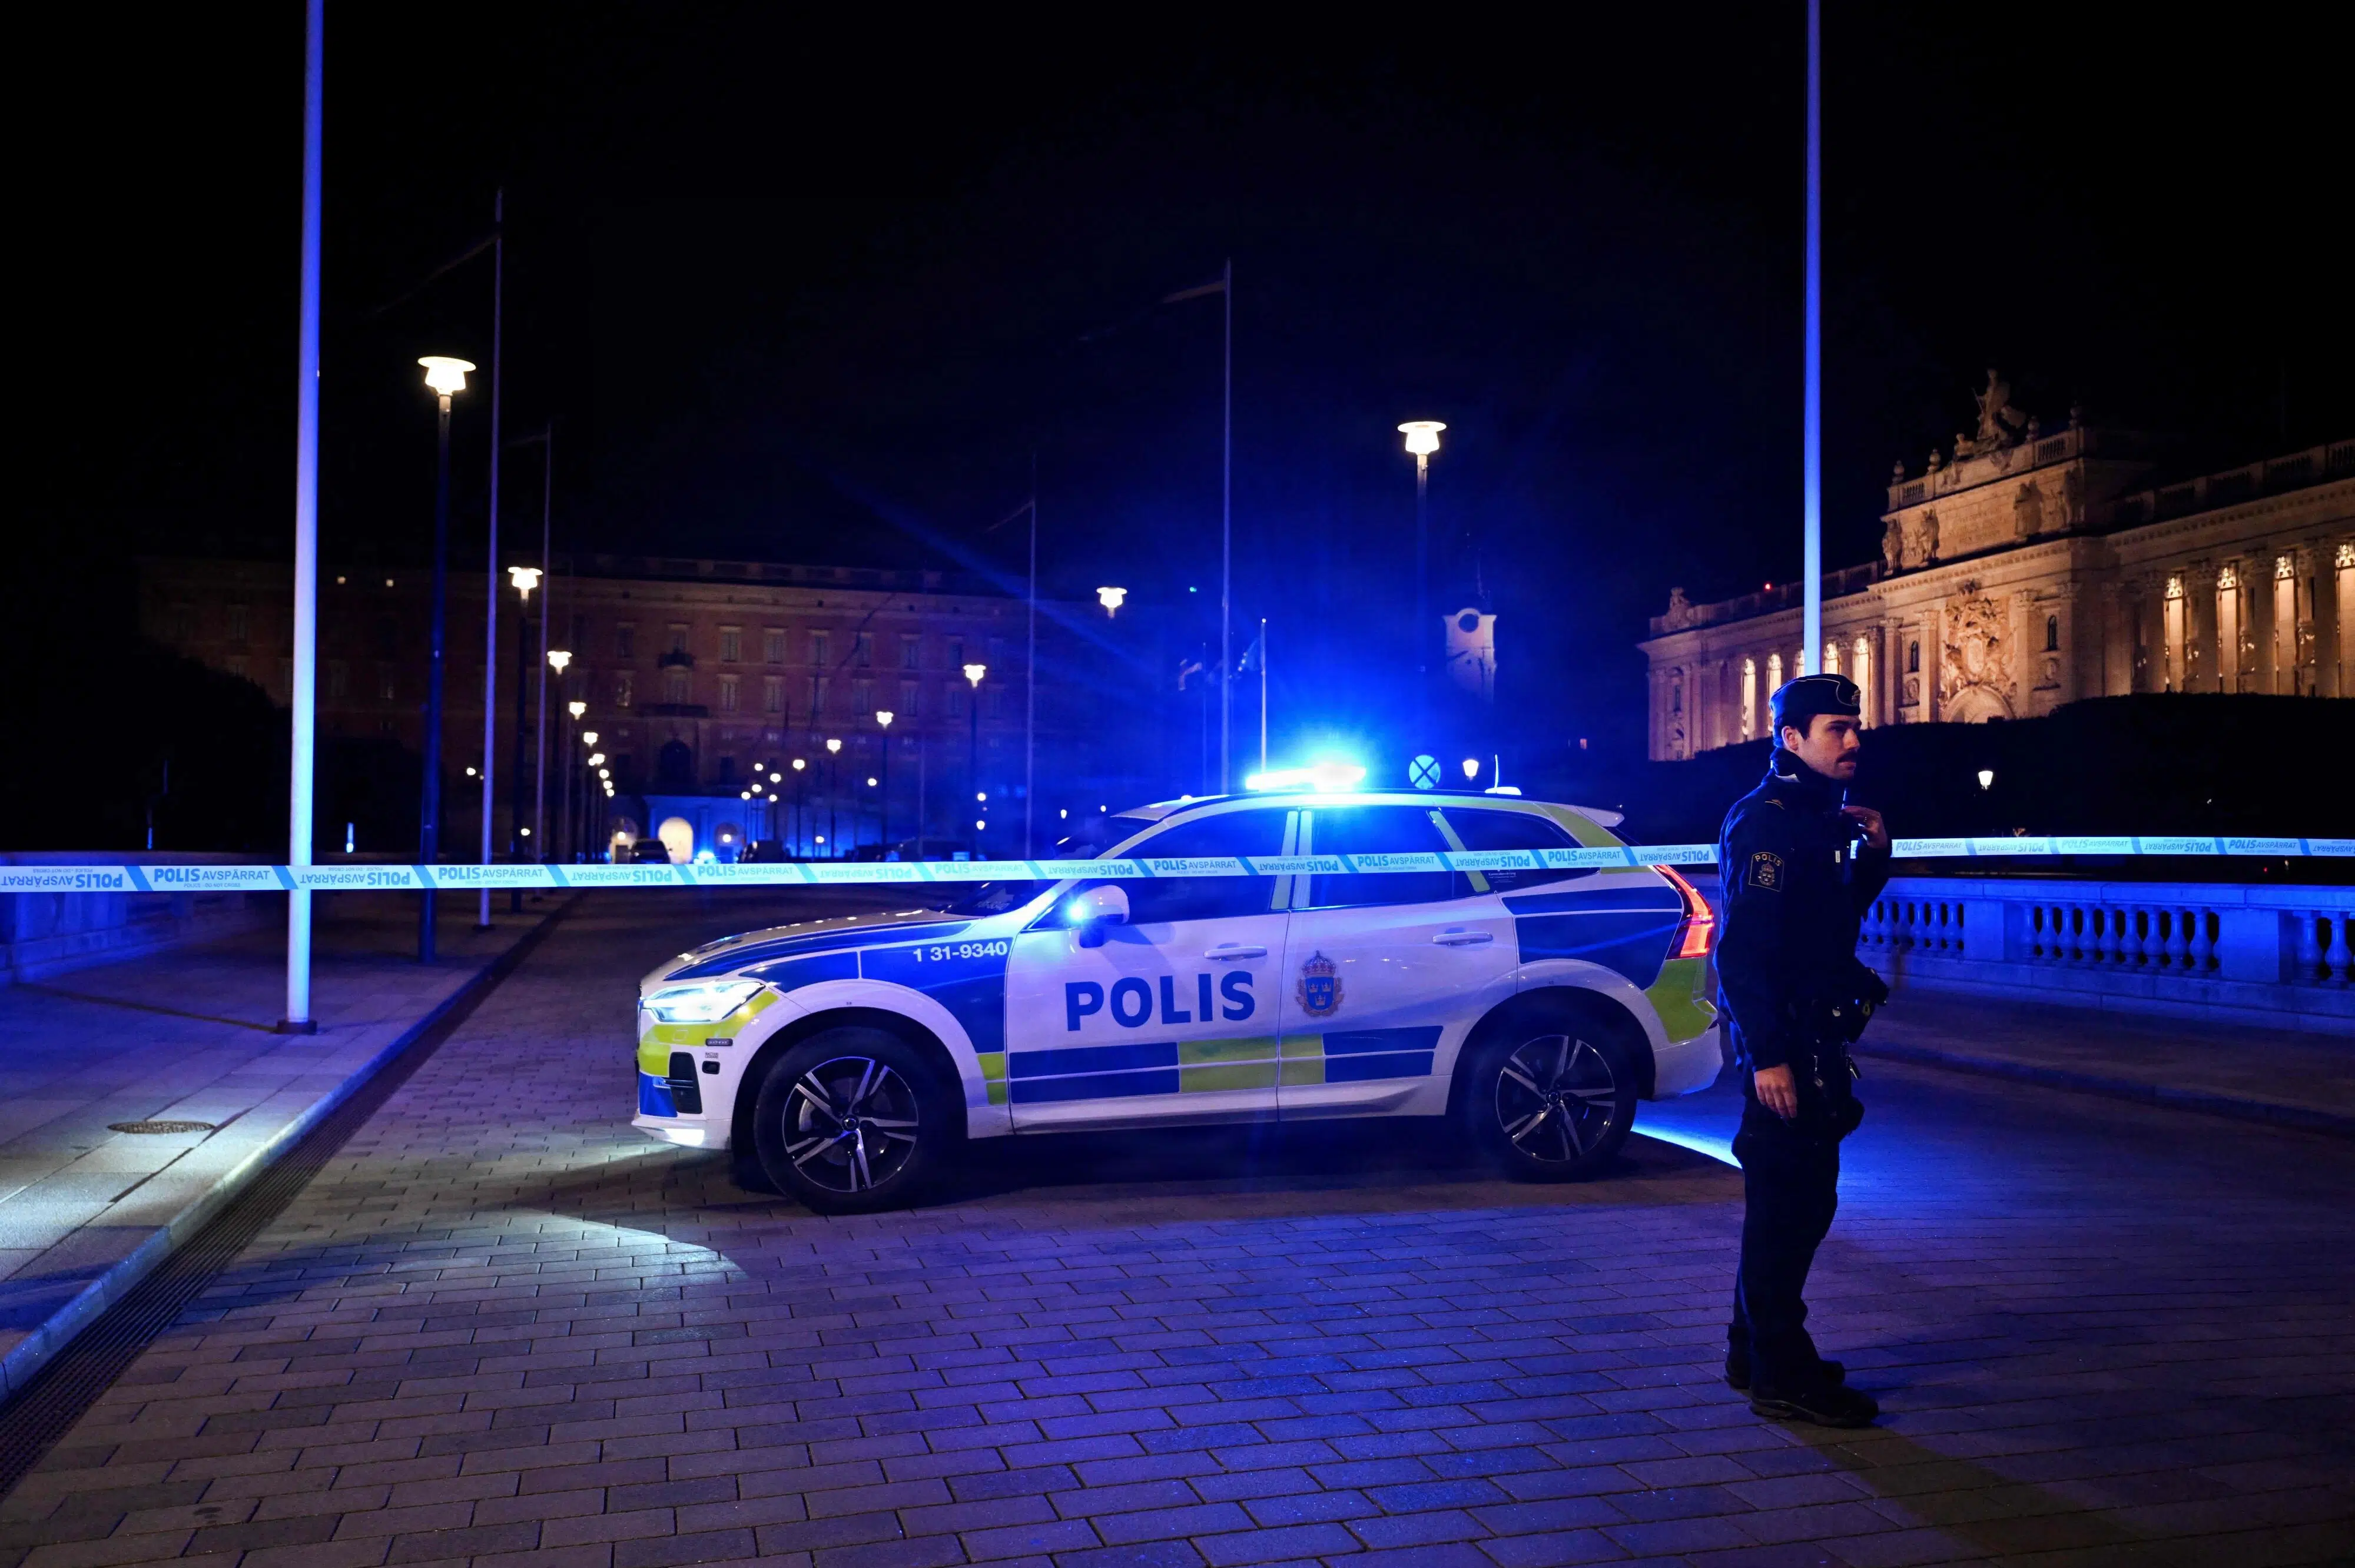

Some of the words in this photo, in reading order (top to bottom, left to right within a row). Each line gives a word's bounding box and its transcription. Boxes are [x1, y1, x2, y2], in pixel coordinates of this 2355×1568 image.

[1896, 841, 1923, 852] POLIS
[2017, 842, 2045, 852] POLIS
[2061, 839, 2089, 849] POLIS
[2184, 842, 2213, 852] POLIS
[2228, 839, 2257, 850] POLIS
[1357, 855, 1388, 867] POLIS
[1389, 855, 1435, 865] AVSPÄRRAT
[1500, 855, 1531, 868] POLIS
[1548, 850, 1577, 862] POLIS
[1578, 851, 1621, 861] AVSPÄRRAT
[1640, 852, 1681, 863] AVSPÄRRAT
[1681, 850, 1710, 862] POLIS
[1754, 853, 1782, 866] POLIS
[934, 863, 971, 874] POLIS
[1099, 863, 1134, 875] POLIS
[1153, 859, 1188, 871] POLIS
[1188, 859, 1237, 869] AVSPÄRRAT
[1258, 861, 1305, 872] AVSPÄRRAT
[1306, 860, 1339, 872] POLIS
[1455, 858, 1500, 868] AVSPÄRRAT
[154, 868, 201, 882] POLIS
[201, 869, 270, 881] AVSPÄRRAT
[438, 867, 481, 880] POLIS
[482, 868, 544, 879] AVSPÄRRAT
[572, 871, 631, 883] AVSPÄRRAT
[632, 870, 672, 883] POLIS
[697, 865, 736, 878] POLIS
[875, 868, 912, 879] POLIS
[1, 875, 74, 888] AVSPÄRRAT
[75, 873, 123, 888] POLIS
[300, 874, 366, 885] AVSPÄRRAT
[367, 872, 410, 886] POLIS
[913, 948, 923, 962] 1
[930, 941, 1008, 961] 31-9340
[1065, 971, 1256, 1032] POLIS
